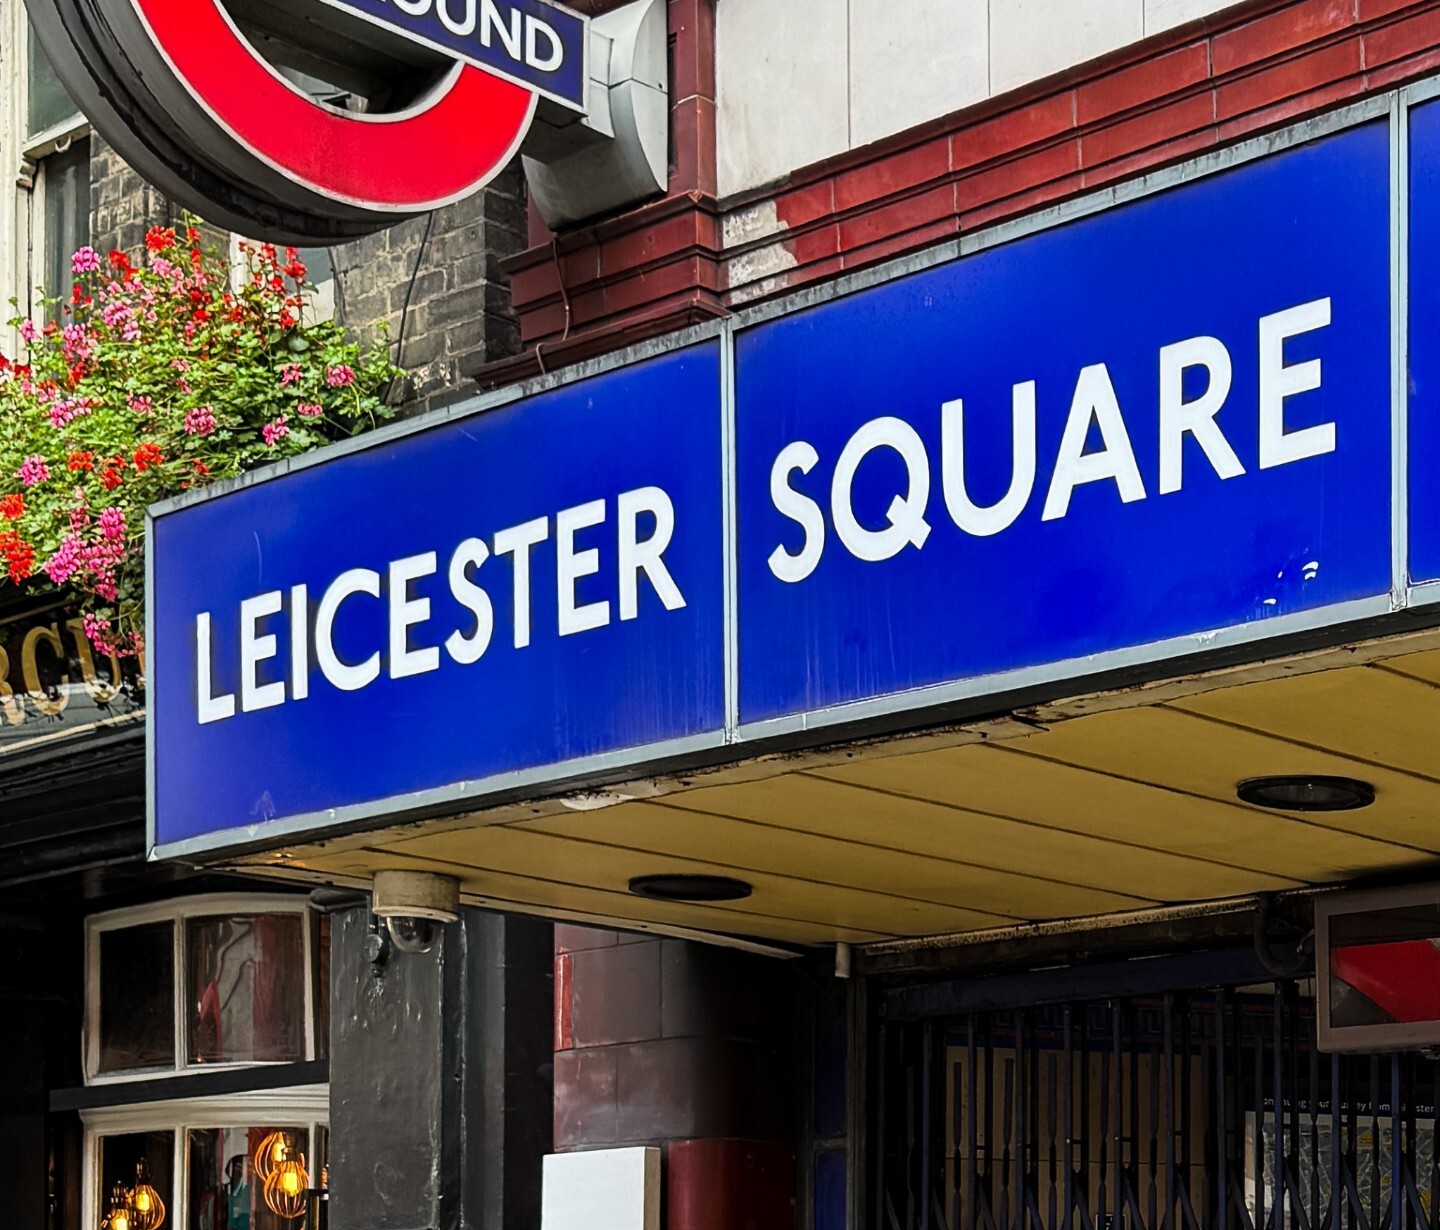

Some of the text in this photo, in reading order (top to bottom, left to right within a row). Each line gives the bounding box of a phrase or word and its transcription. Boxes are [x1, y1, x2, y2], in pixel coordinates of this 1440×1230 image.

[393, 0, 563, 71] UND
[197, 486, 687, 725] LEICESTER
[767, 297, 1336, 583] SQUARE
[0, 618, 145, 727] CU
